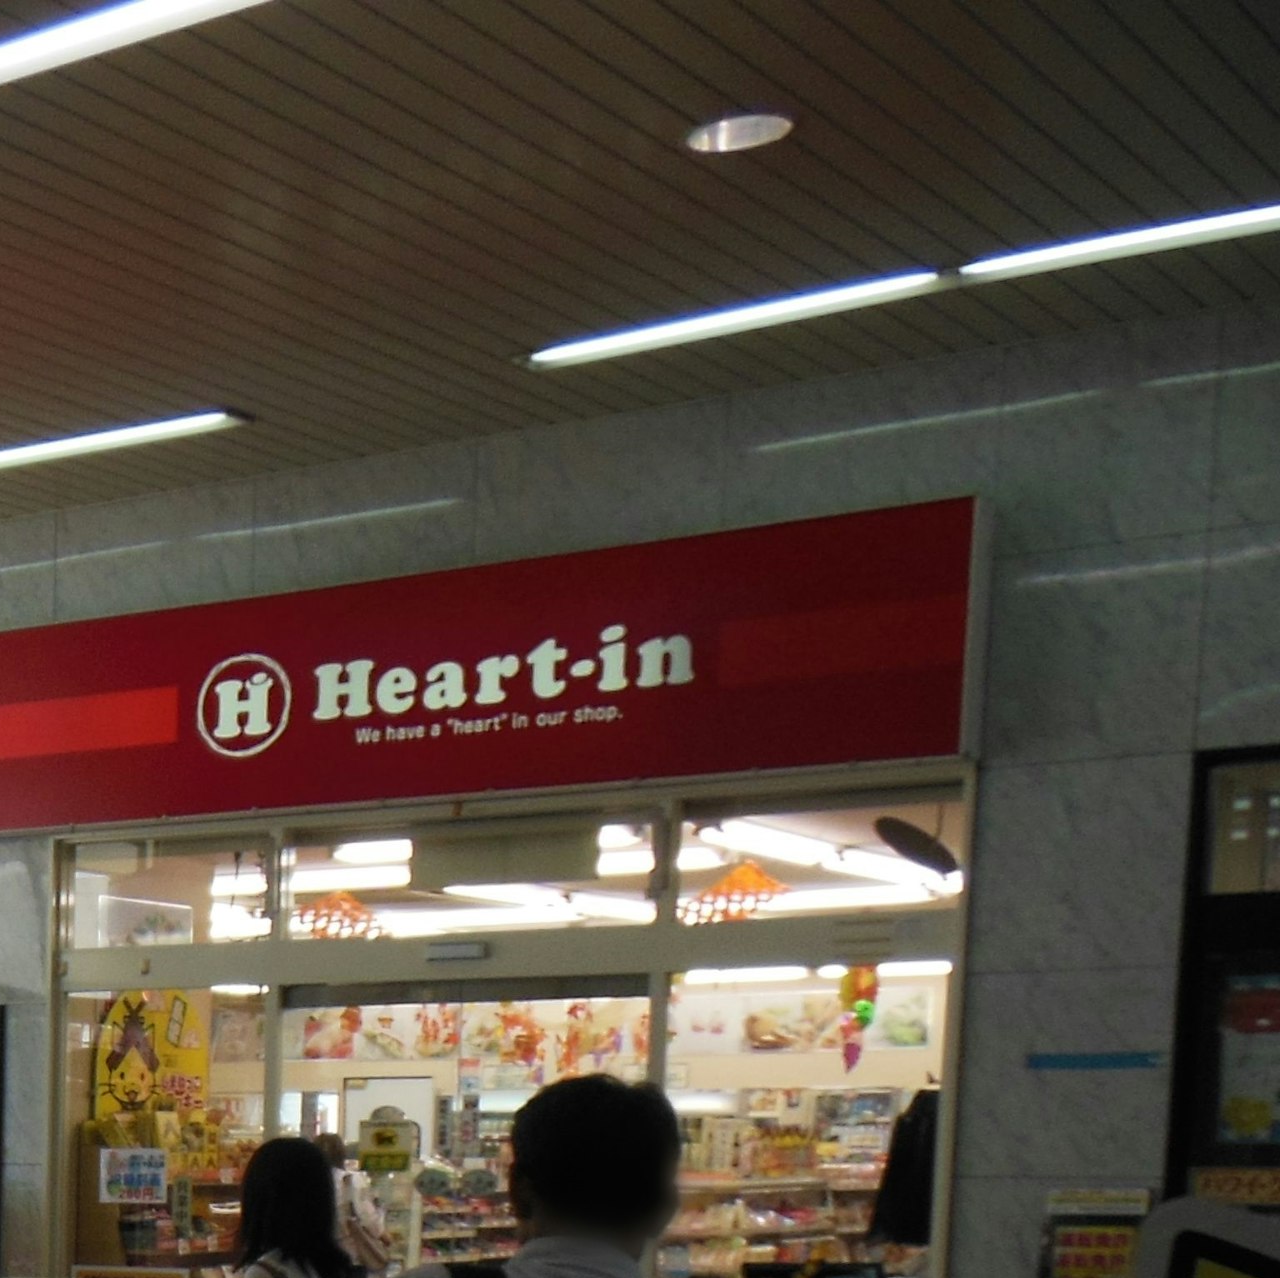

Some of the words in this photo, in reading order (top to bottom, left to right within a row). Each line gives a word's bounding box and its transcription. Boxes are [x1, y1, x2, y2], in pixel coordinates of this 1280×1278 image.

[312, 624, 695, 721] Heart-in
[355, 726, 381, 744] We
[385, 723, 425, 741] have
[430, 725, 441, 737] a
[445, 714, 507, 736] "heart"
[511, 711, 529, 729] in
[536, 710, 566, 726] our
[572, 704, 623, 725] shop.
